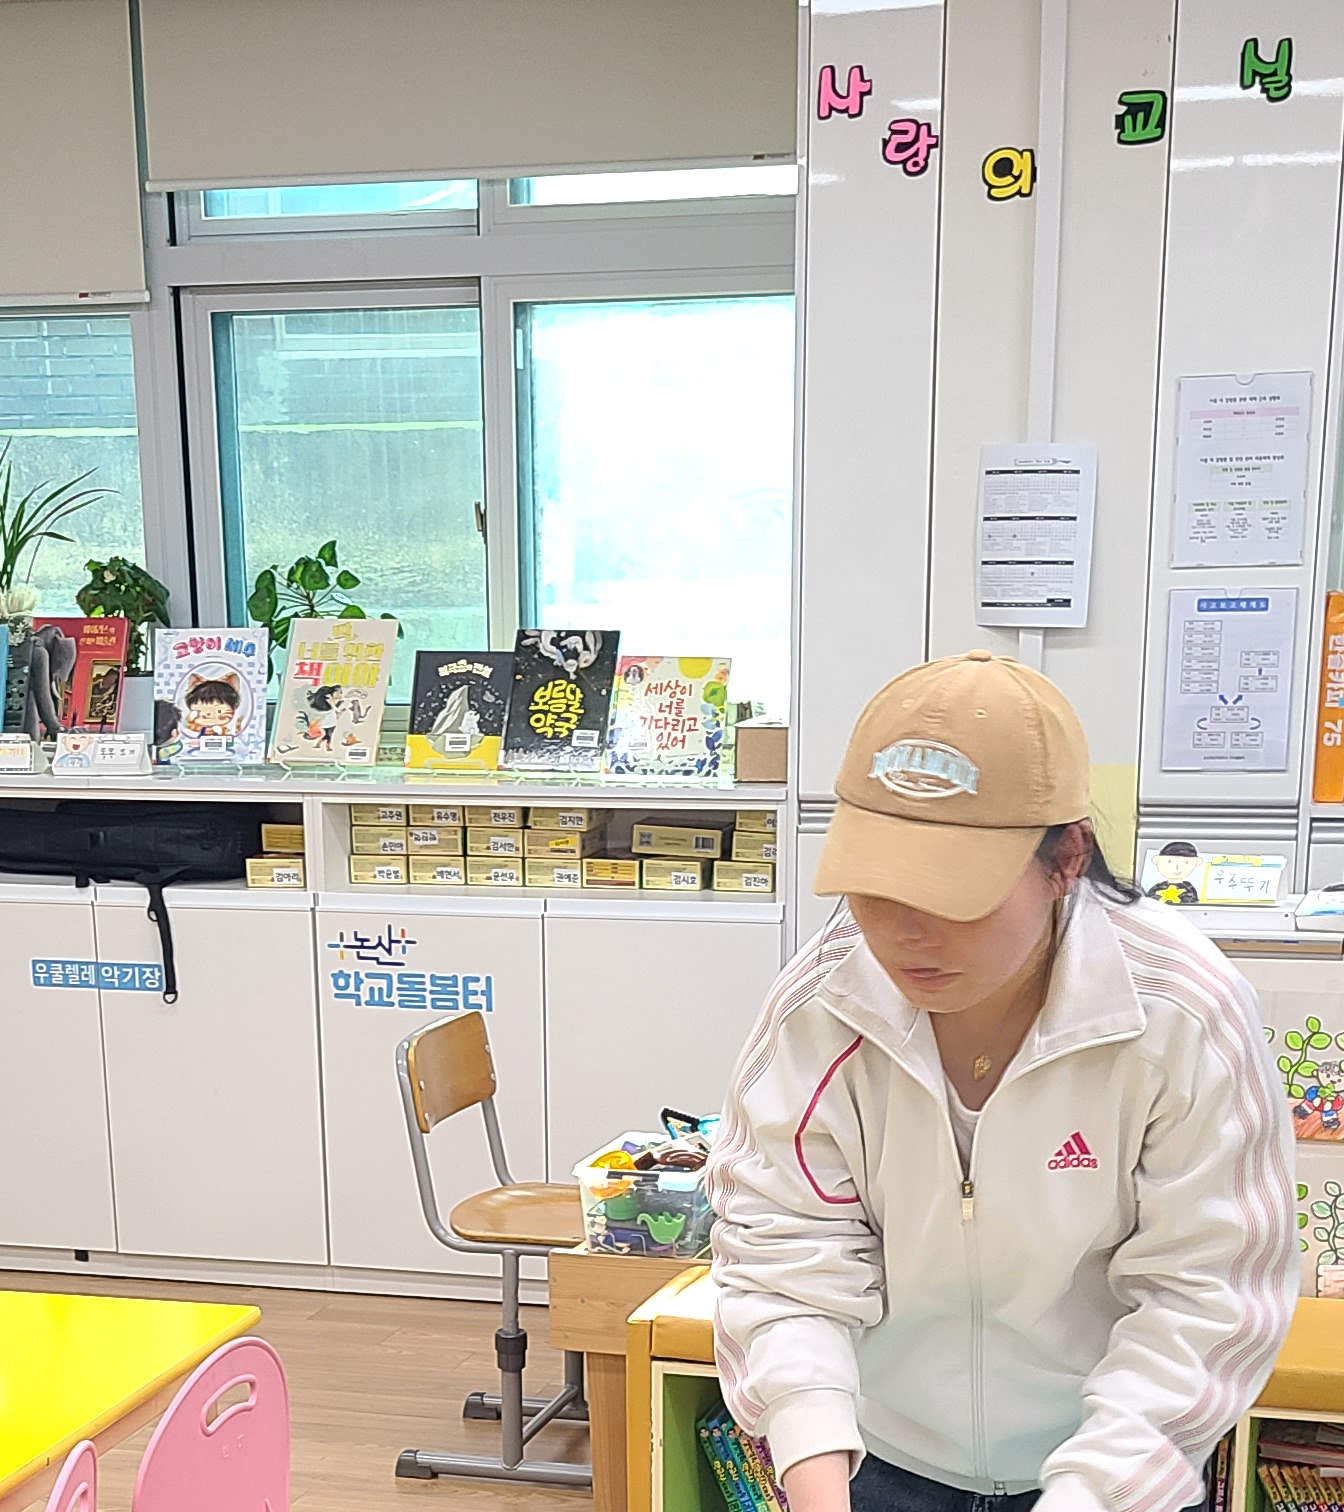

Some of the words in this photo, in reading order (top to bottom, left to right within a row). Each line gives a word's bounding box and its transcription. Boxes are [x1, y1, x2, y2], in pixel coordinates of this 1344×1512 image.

[172, 636, 223, 660] 고양이
[293, 661, 380, 688] 책이야
[529, 679, 586, 714] 보름달
[644, 680, 693, 699] 세상이
[658, 698, 686, 717] 너를
[529, 712, 578, 739] 약국
[639, 715, 699, 733] 기다리고
[1322, 719, 1343, 747] 75
[656, 732, 686, 750] 있어
[327, 924, 417, 967] 논산
[34, 962, 96, 985] 우쿨렐레
[101, 965, 161, 988] 악기장
[330, 969, 494, 1013] 학교돌봄터
[1047, 1155, 1098, 1170] adidas
